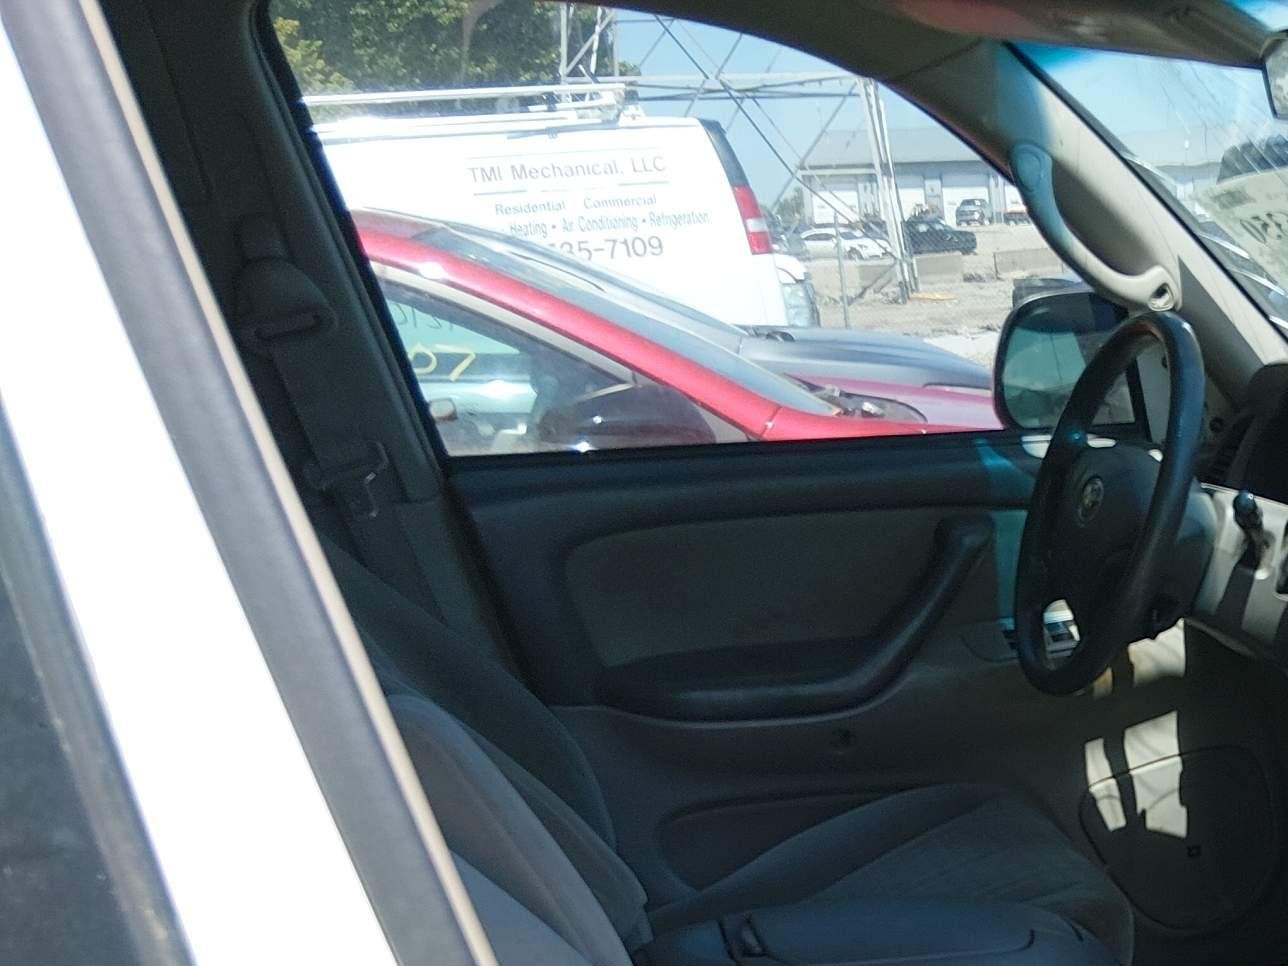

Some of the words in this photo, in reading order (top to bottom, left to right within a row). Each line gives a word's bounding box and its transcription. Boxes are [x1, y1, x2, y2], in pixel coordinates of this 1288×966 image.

[467, 166, 503, 183] TMI
[630, 155, 667, 173] LLC
[494, 200, 567, 216] Residential
[583, 193, 657, 211] Commercial
[561, 217, 576, 233] Air
[577, 214, 639, 233] Conditioning
[648, 210, 710, 230] Refrigeration
